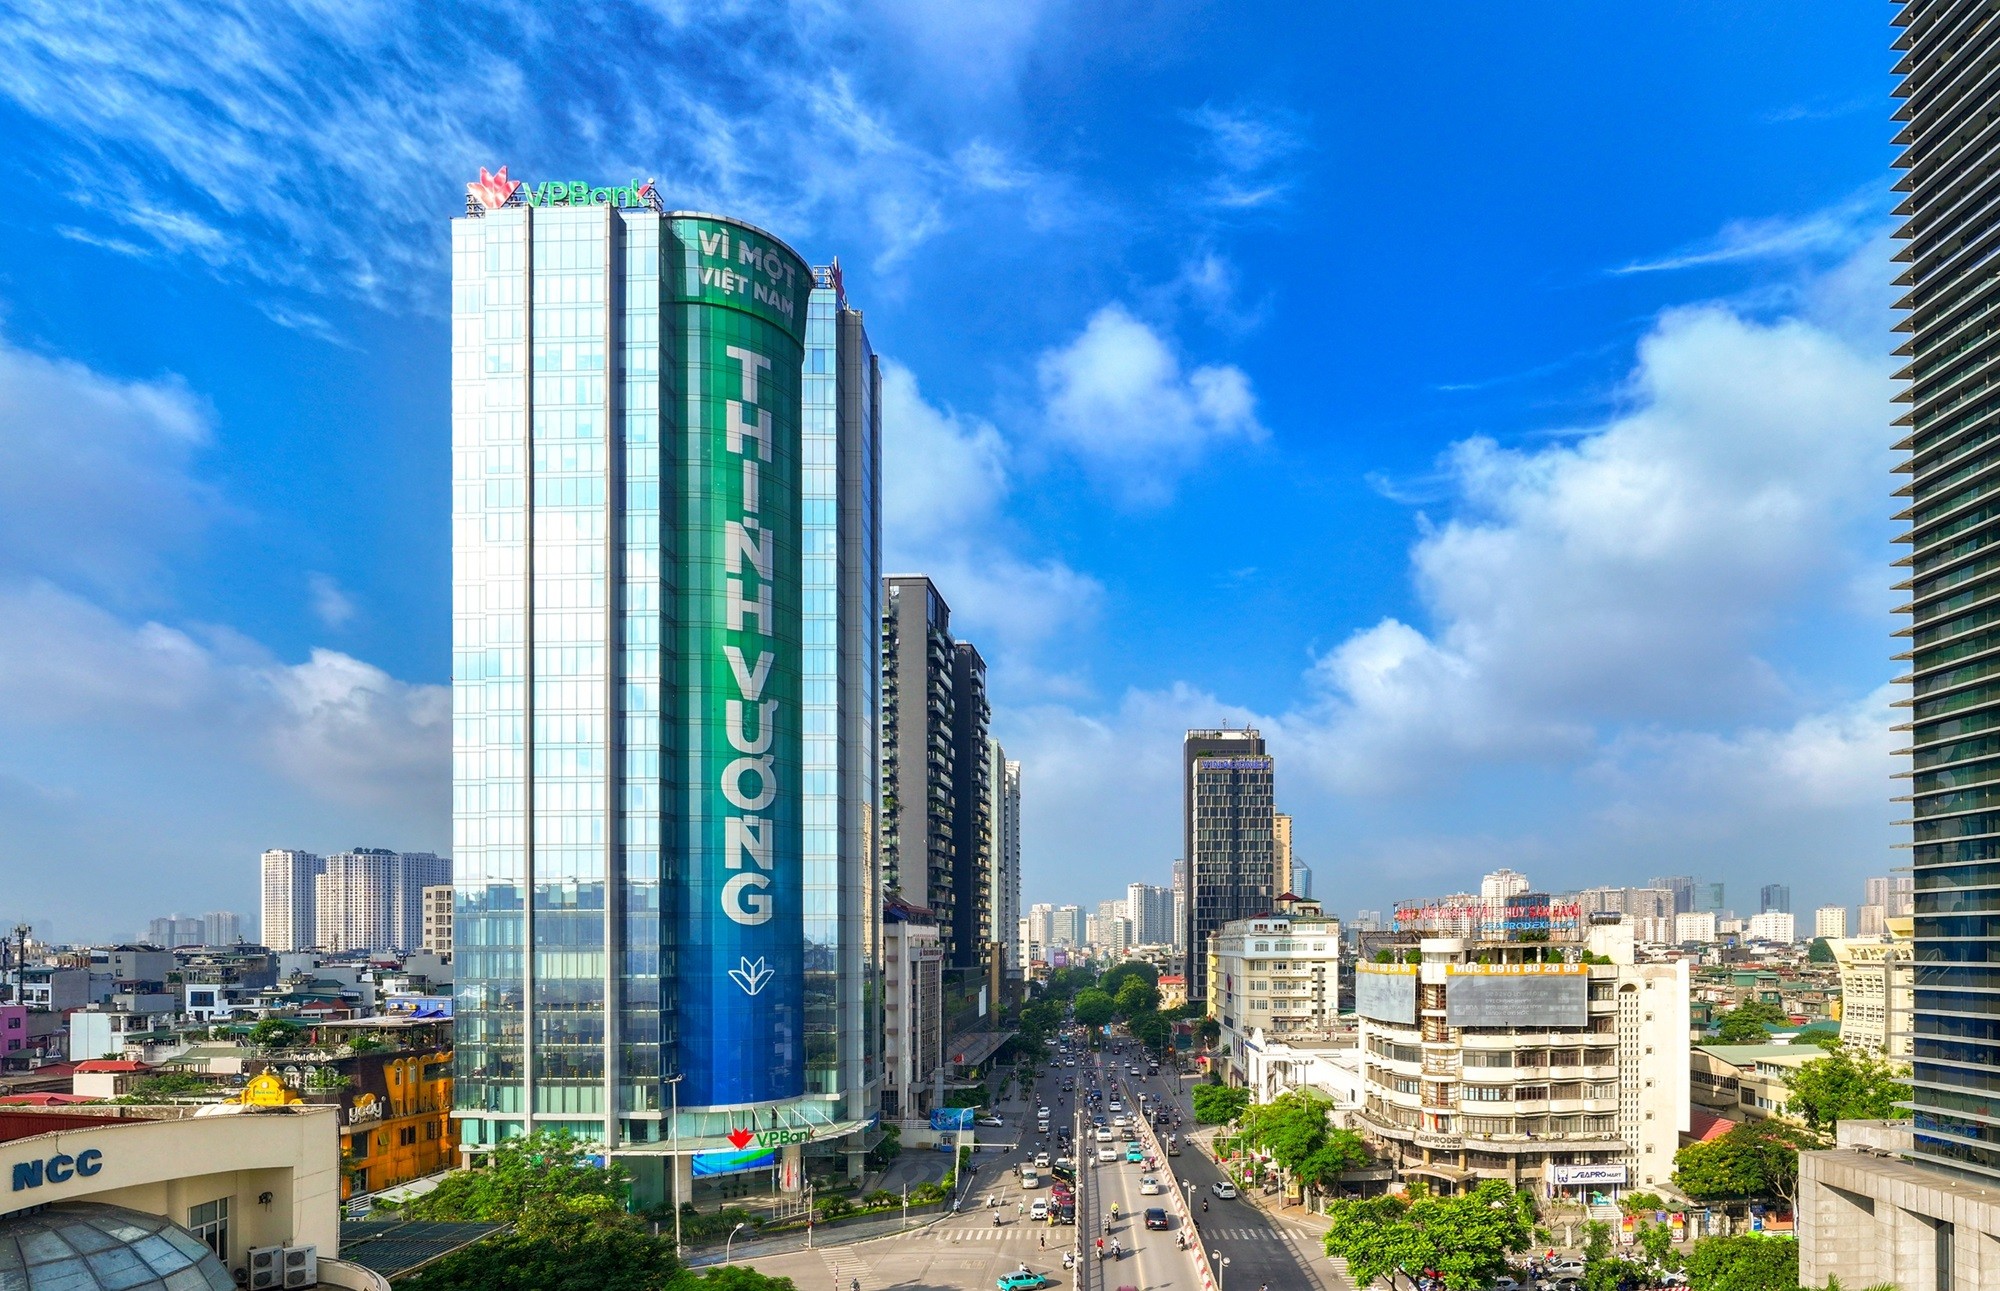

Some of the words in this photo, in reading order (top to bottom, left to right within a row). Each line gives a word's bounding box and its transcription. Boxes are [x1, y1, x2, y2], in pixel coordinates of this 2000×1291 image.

[521, 178, 651, 208] VPBank
[699, 227, 730, 260] VÌ
[739, 239, 795, 289] MỘT
[697, 265, 749, 296] VIỆT
[753, 282, 795, 319] NAM
[1490, 964, 1520, 973] 0916
[1524, 963, 1540, 973] 80
[1544, 963, 1559, 973] 20
[1563, 963, 1579, 973] 99
[756, 1127, 816, 1148] VPBank
[12, 1148, 103, 1193] NCC
[1571, 1171, 1607, 1179] SEAPRO
